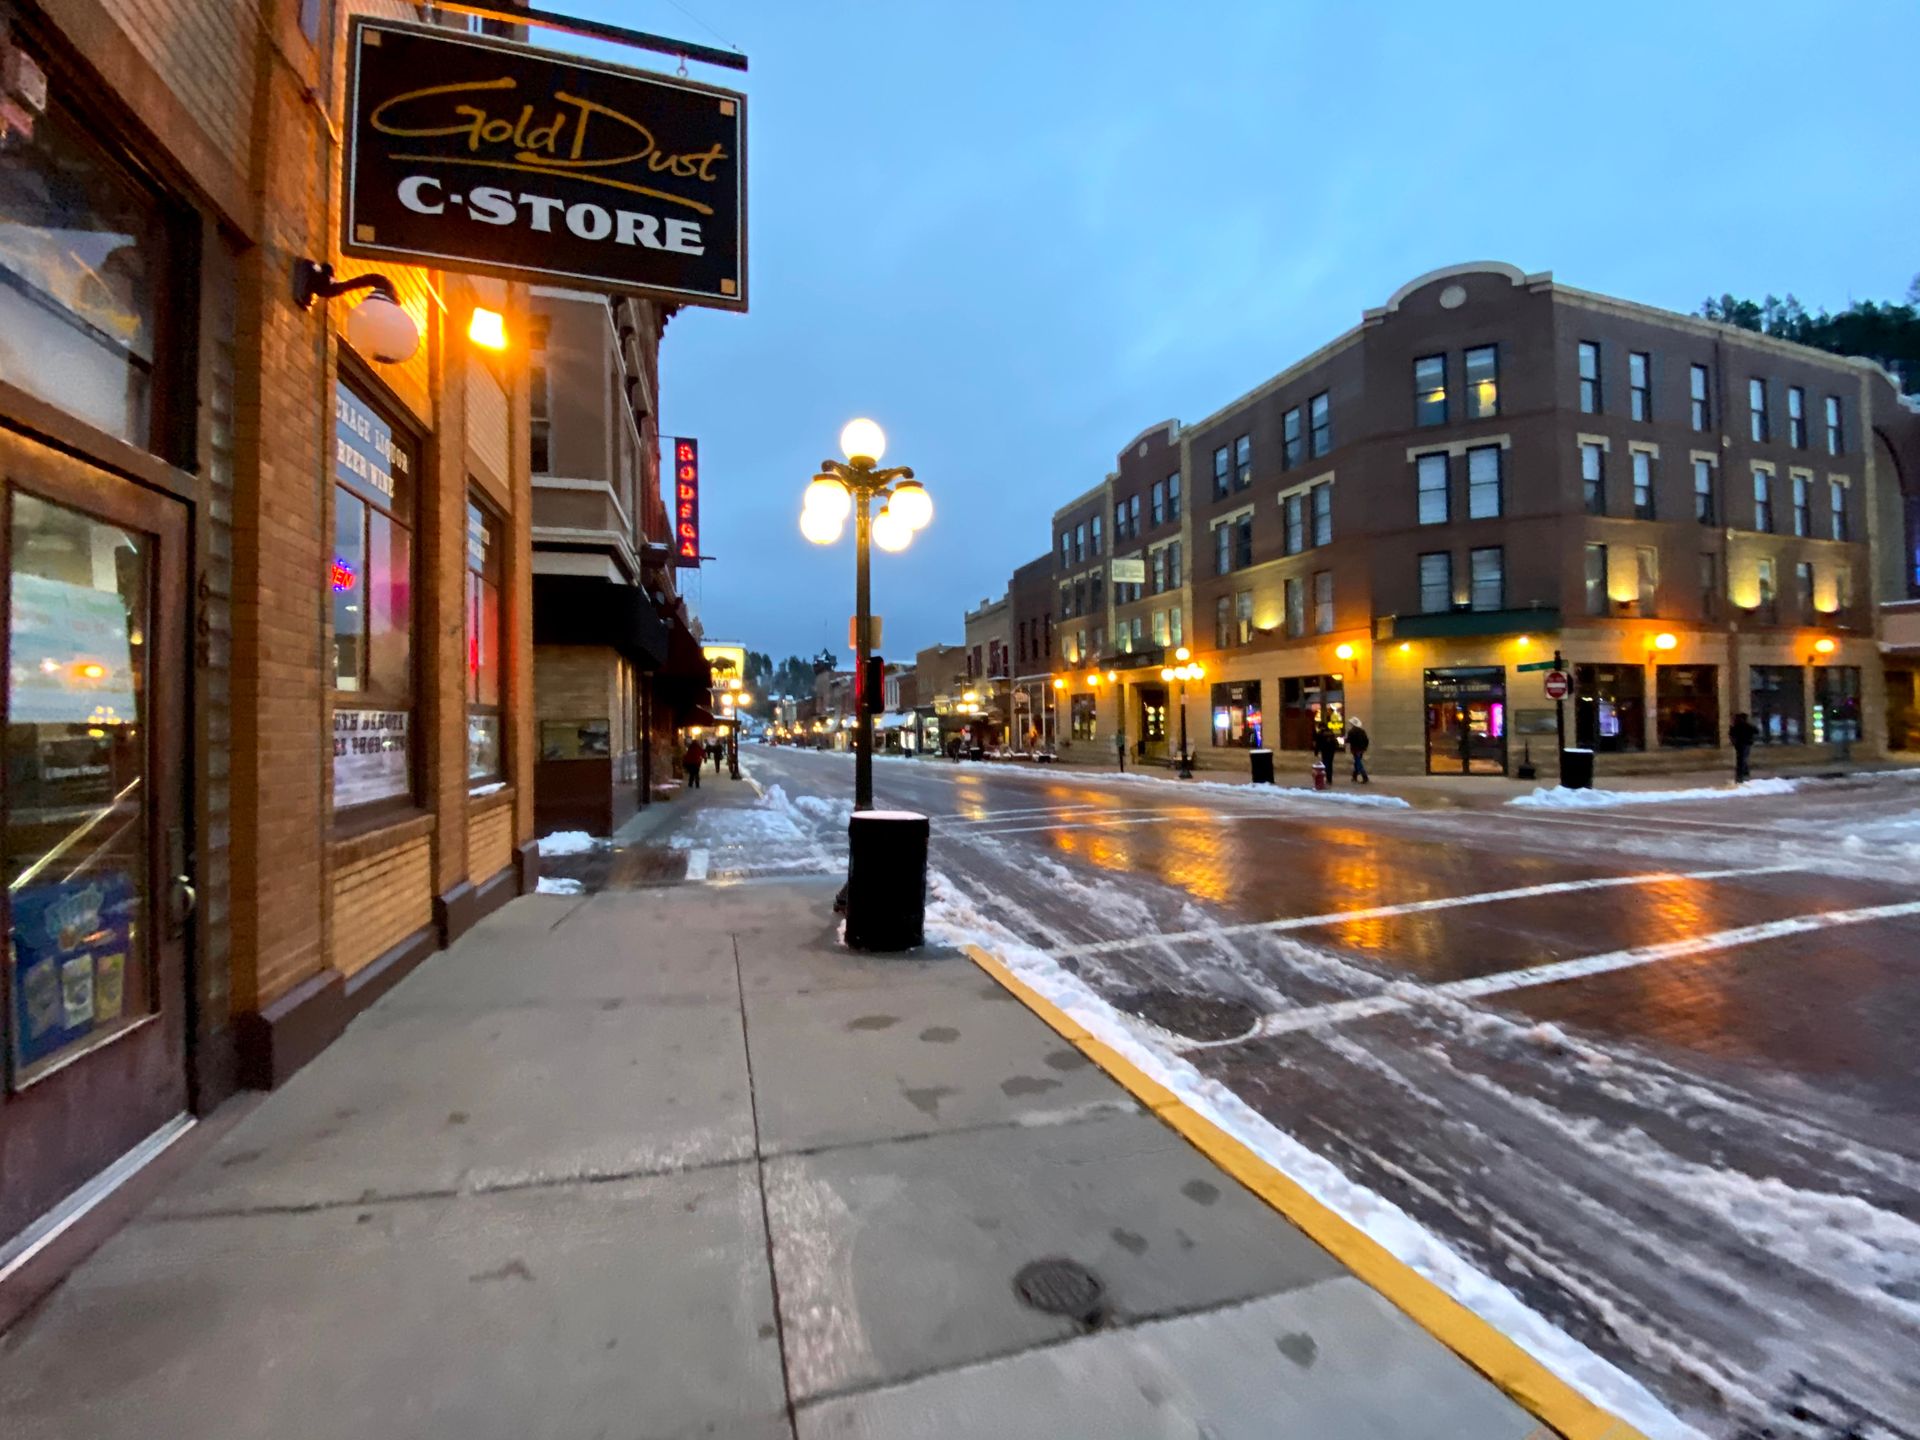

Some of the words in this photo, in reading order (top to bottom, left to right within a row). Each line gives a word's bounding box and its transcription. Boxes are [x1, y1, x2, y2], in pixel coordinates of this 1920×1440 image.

[371, 77, 566, 152] Gold
[515, 91, 728, 182] Dust
[398, 176, 705, 256] C-STORE
[679, 444, 696, 557] BODEGA
